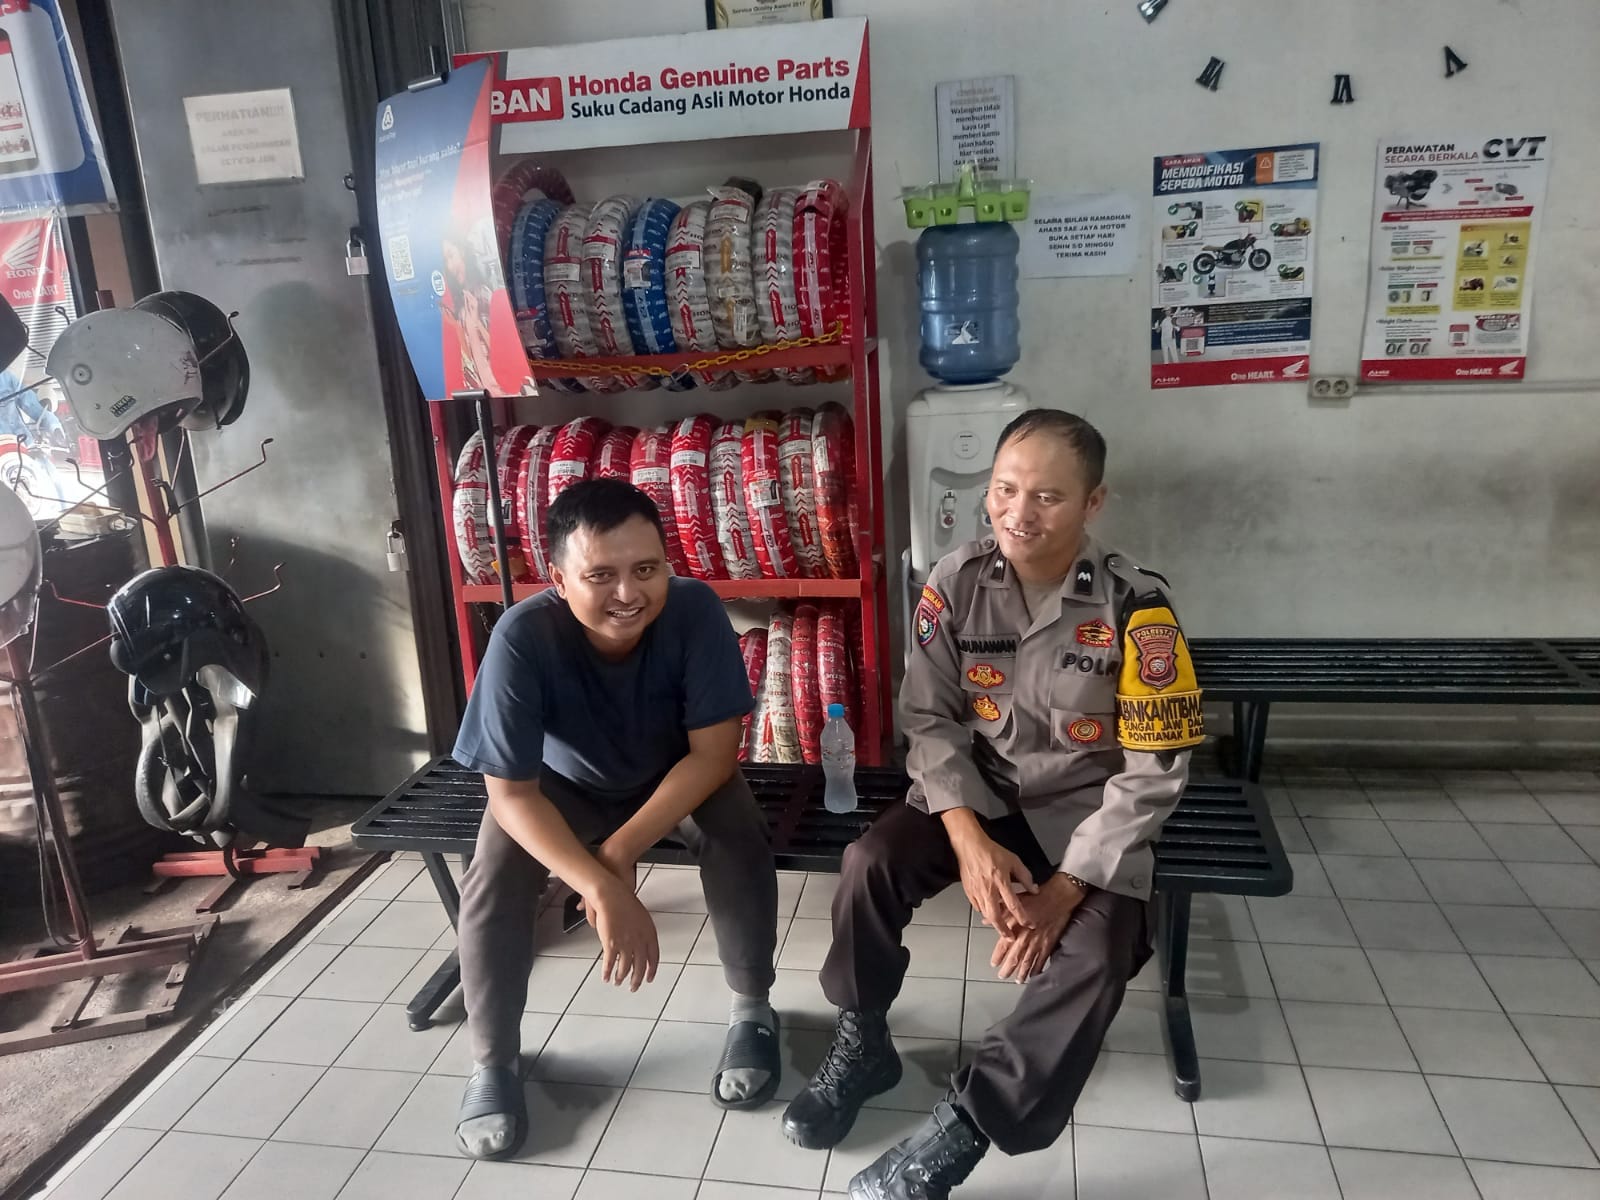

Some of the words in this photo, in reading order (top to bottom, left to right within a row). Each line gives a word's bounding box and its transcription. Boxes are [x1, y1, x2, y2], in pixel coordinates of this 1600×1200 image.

[568, 71, 652, 96] Honda
[660, 63, 770, 90] Genuine
[777, 56, 850, 81] Parts
[490, 88, 551, 115] BAN
[571, 101, 615, 118] Suku
[619, 96, 687, 115] Cadang
[692, 91, 723, 110] Asli
[729, 89, 784, 107] Motor
[789, 82, 850, 102] Honda
[1386, 144, 1455, 154] PERAWATAN
[1482, 136, 1547, 159] CVT
[1385, 154, 1425, 163] SECARA
[1428, 151, 1479, 162] BERKALA
[1161, 162, 1244, 179] MEMODIFIKASI
[1160, 178, 1202, 191] SEPEDA
[1203, 174, 1244, 188] MOTOR
[1089, 214, 1131, 222] RAMADHAN
[7, 266, 53, 279] HONA
[12, 288, 33, 299] One
[1231, 372, 1247, 380] One
[1062, 652, 1120, 677] POLR
[1124, 720, 1155, 732] SUNGAI
[1160, 719, 1184, 731] JAWI
[1128, 730, 1184, 742] PONTIANAK
